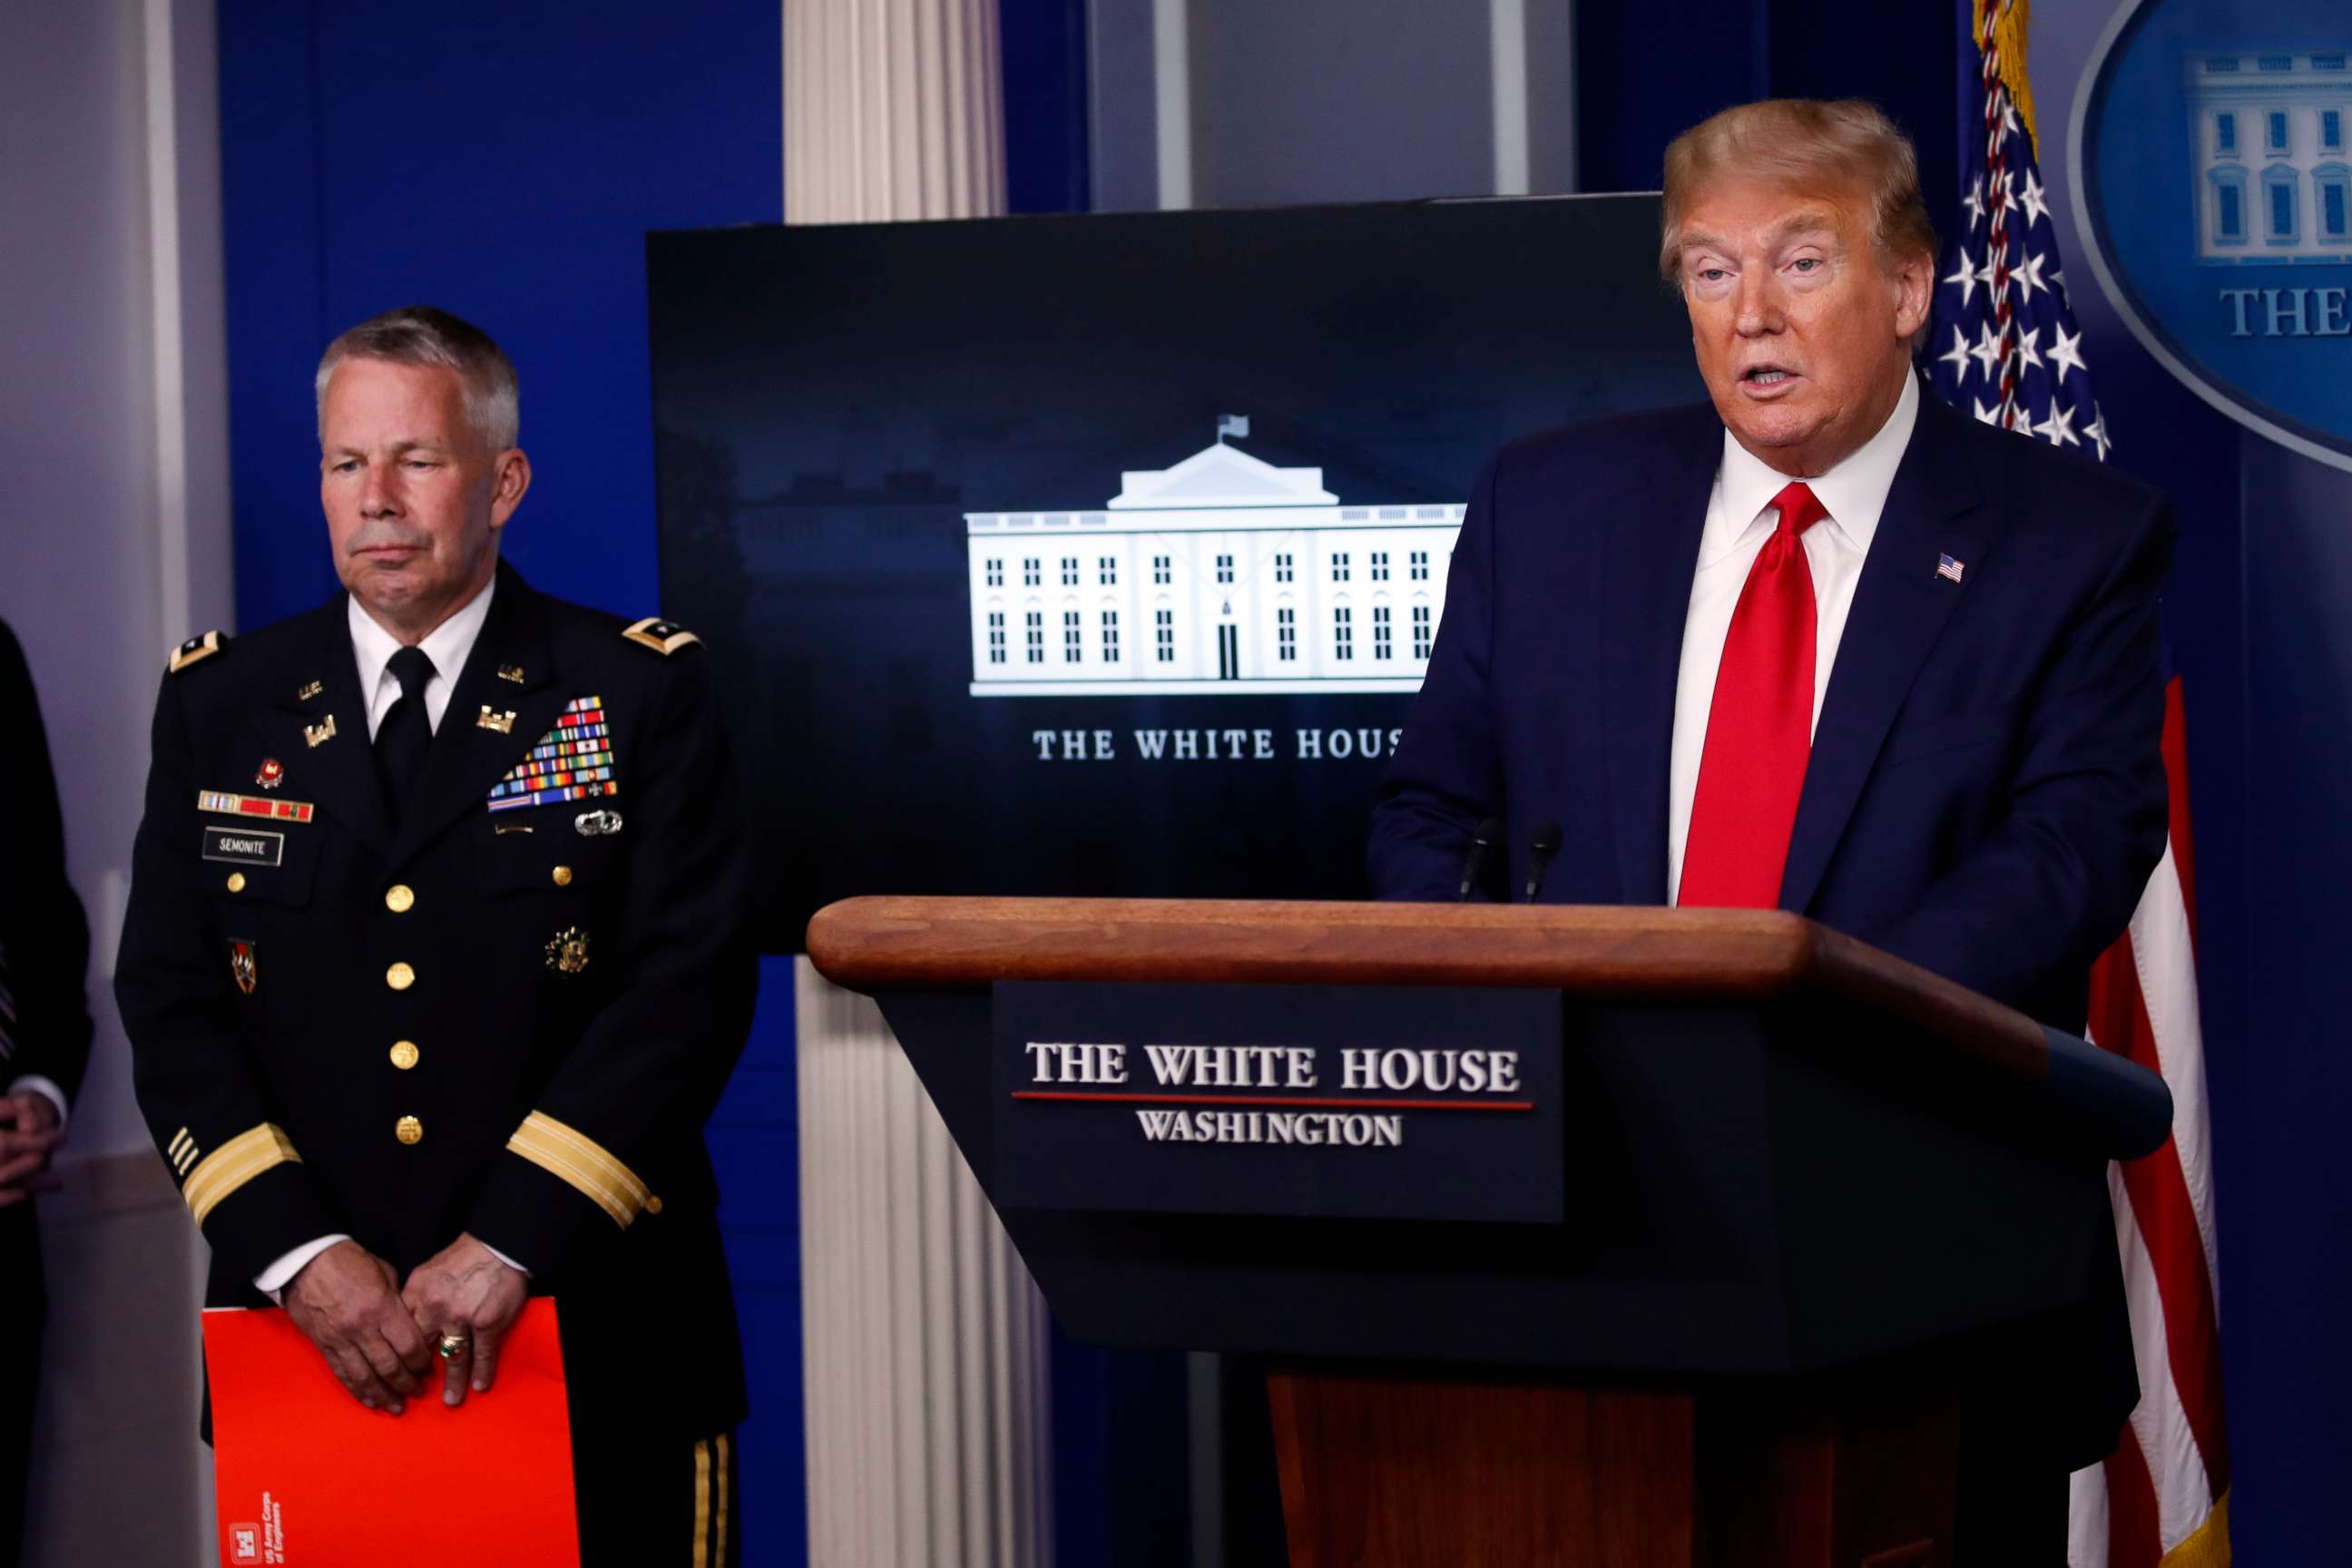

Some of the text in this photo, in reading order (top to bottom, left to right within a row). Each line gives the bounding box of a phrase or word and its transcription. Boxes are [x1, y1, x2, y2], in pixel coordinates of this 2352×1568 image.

[2220, 288, 2351, 335] THE
[1033, 730, 1116, 760] THE
[1134, 729, 1275, 760] WHITE
[220, 838, 265, 855] SEMONITE
[1025, 1042, 1521, 1093] THE WHITE HOUSE
[1136, 1110, 1403, 1146] WASHINGTON
[262, 1492, 275, 1563] US Army Corps
[272, 1502, 284, 1563] of Engineers
